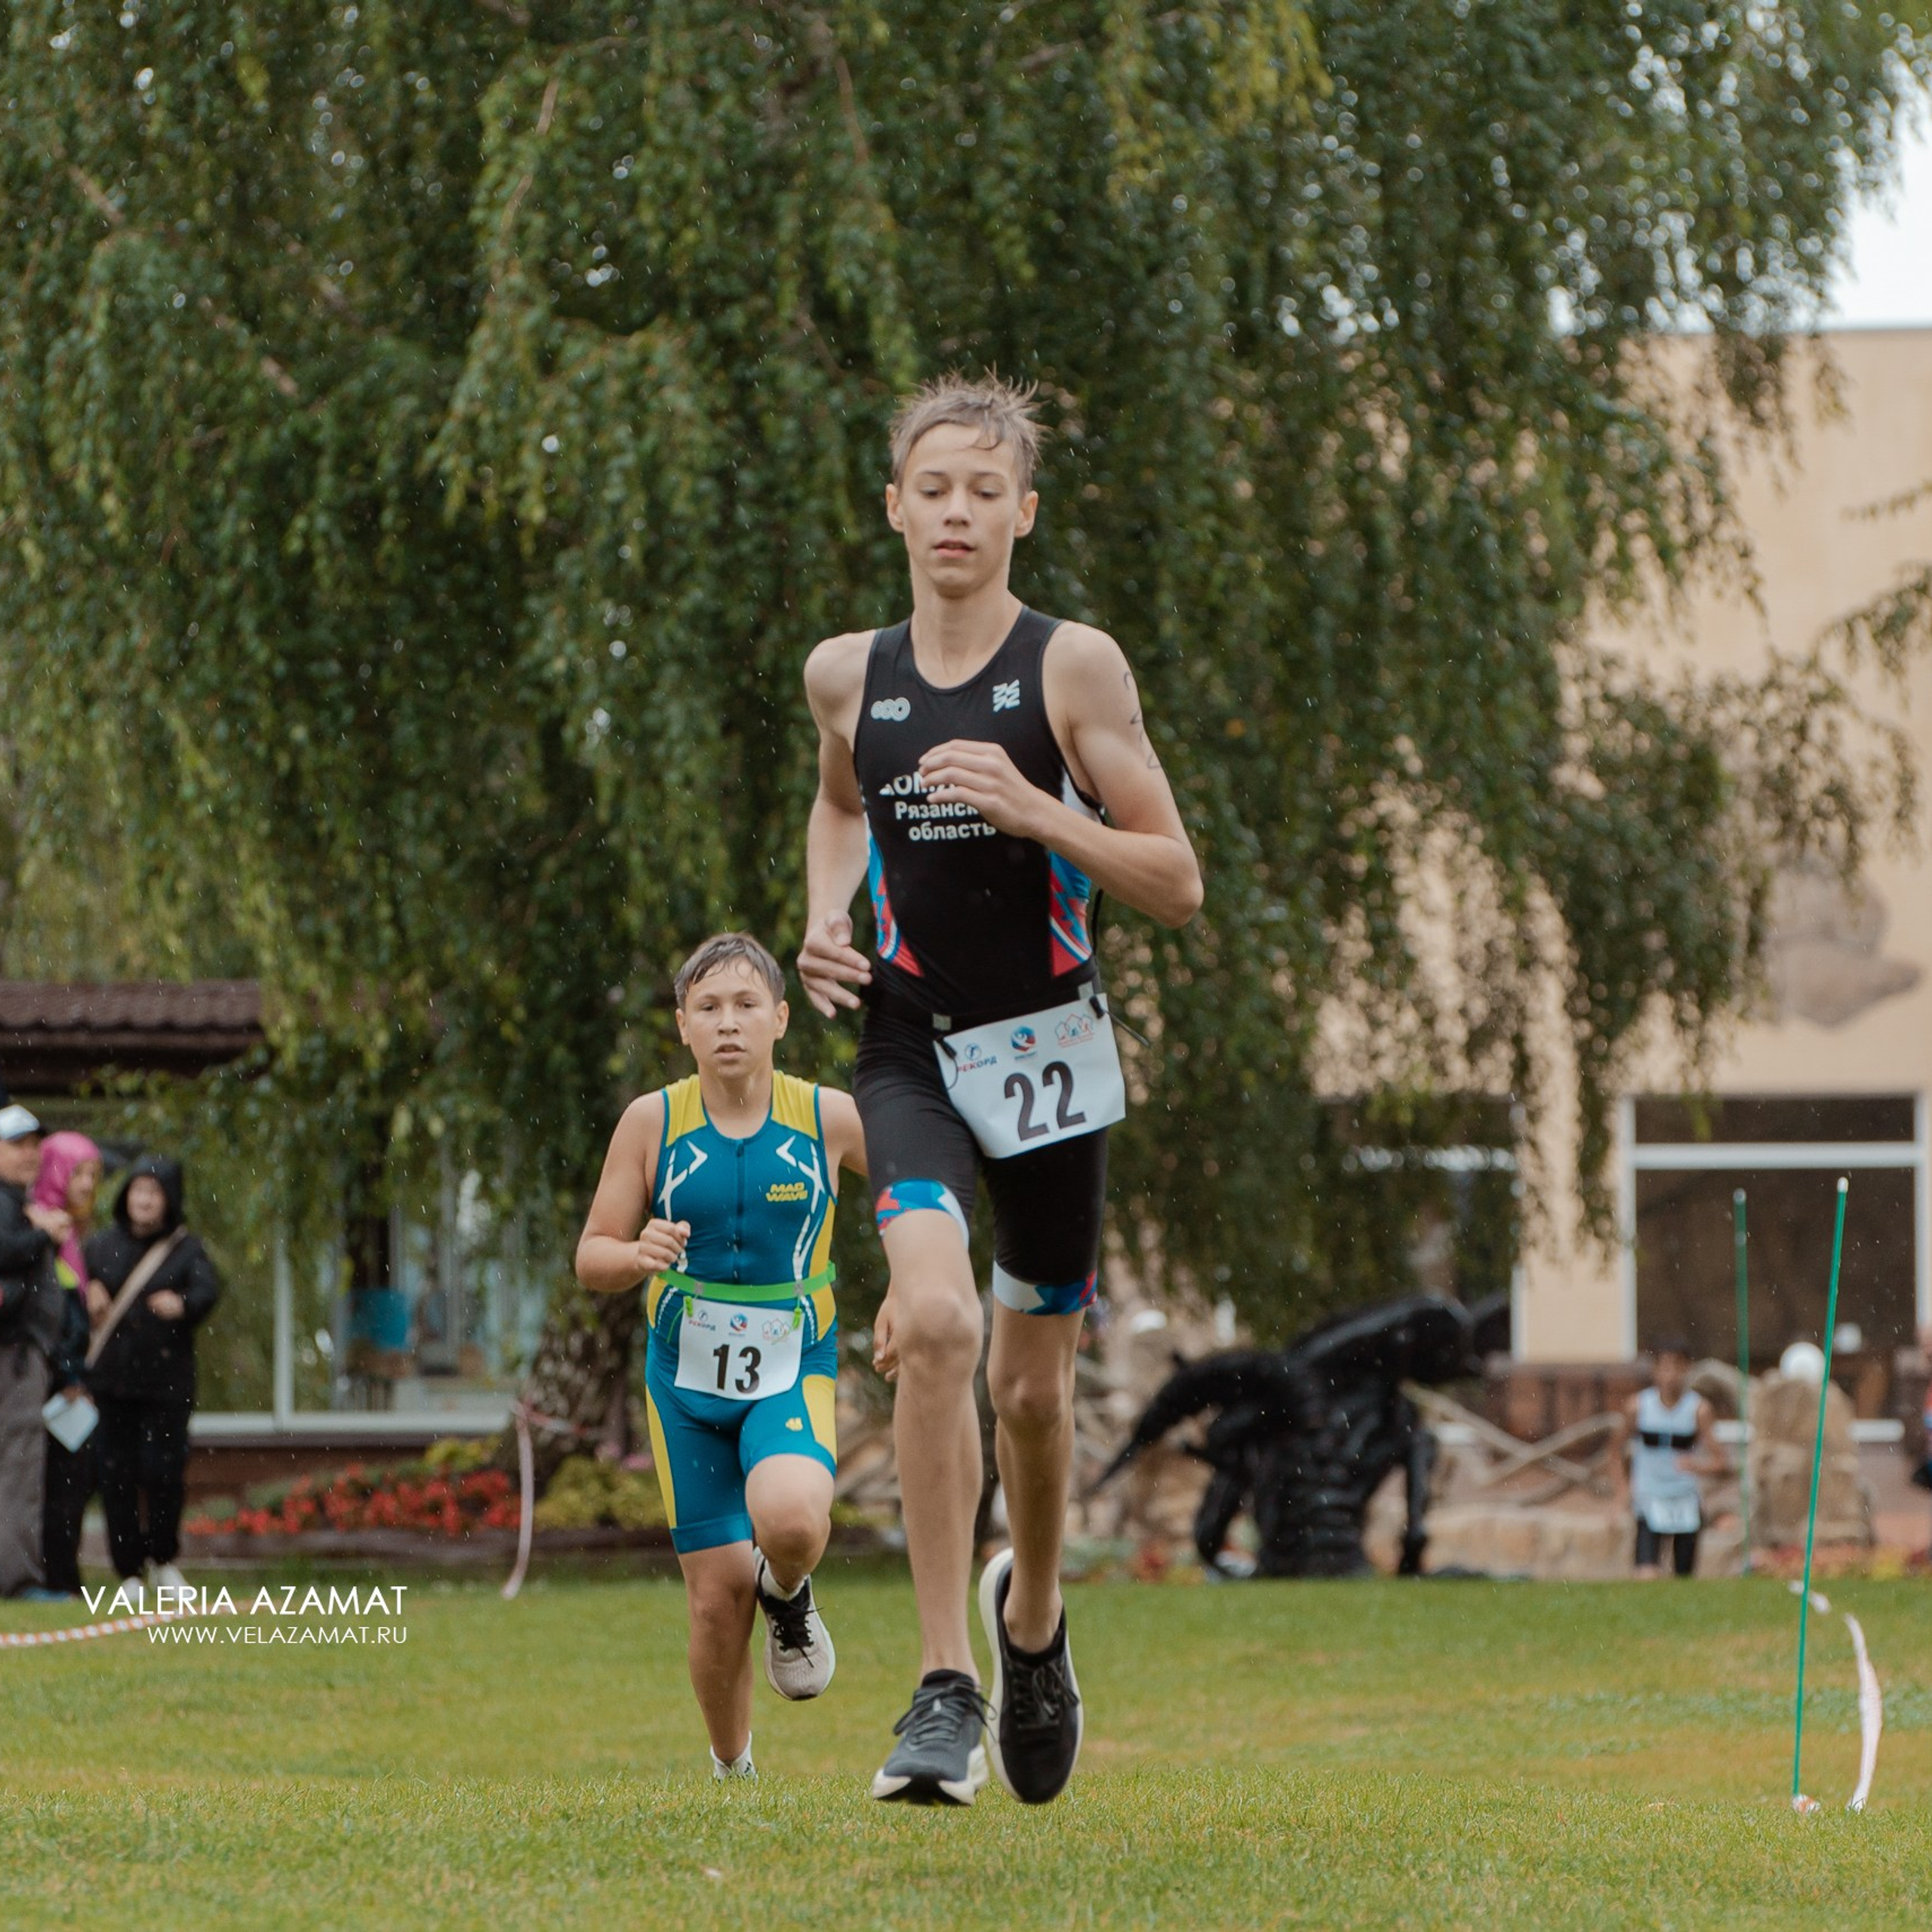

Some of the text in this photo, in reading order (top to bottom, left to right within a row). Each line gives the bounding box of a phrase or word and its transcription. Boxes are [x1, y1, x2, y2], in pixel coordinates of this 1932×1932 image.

[909, 821, 996, 841] область
[1004, 1060, 1086, 1141] 22
[713, 1344, 761, 1394] 13
